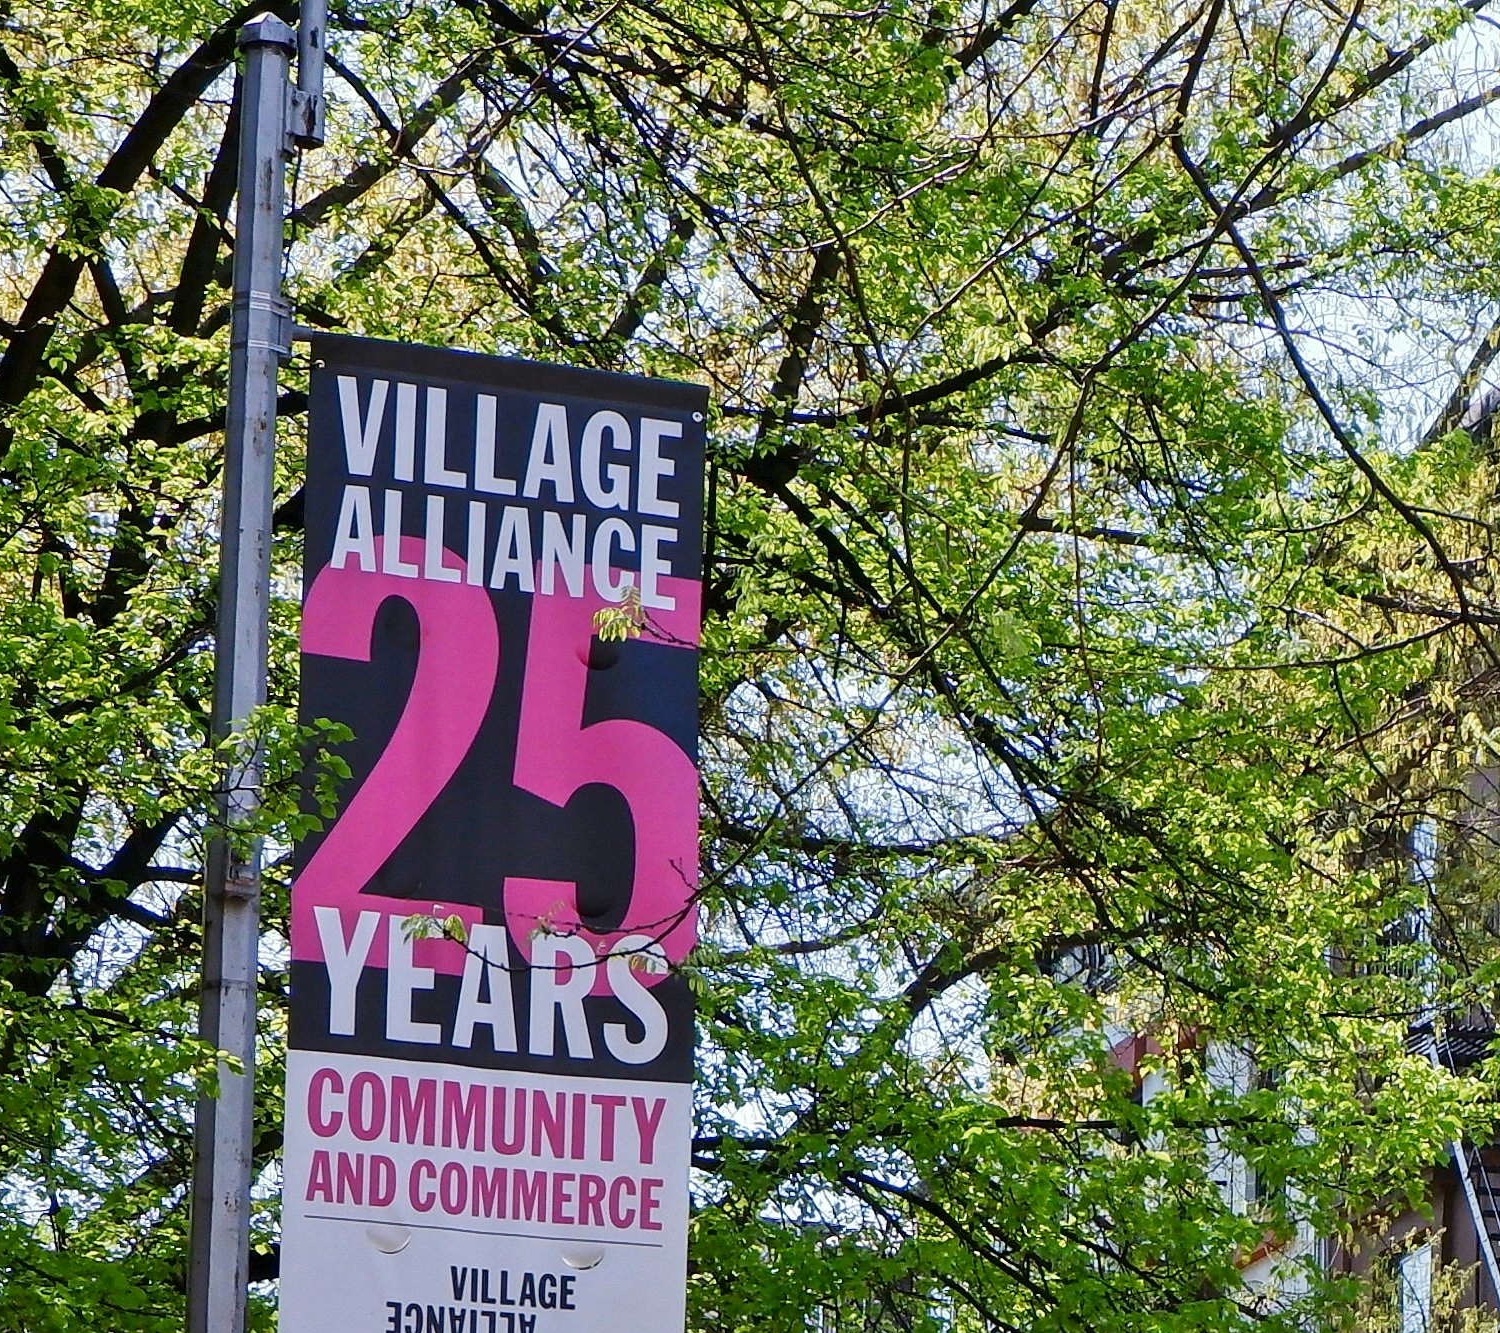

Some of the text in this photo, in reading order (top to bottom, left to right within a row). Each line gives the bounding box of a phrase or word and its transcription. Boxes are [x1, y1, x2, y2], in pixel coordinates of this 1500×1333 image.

[336, 375, 684, 519] VILLAGE
[330, 484, 679, 611] ALLIANCE
[291, 535, 703, 997] 25
[313, 905, 669, 1065] YEARS
[307, 1068, 667, 1165] COMMUNITY
[305, 1150, 664, 1231] AND COMMERCE
[450, 1265, 577, 1311] VILLAGE
